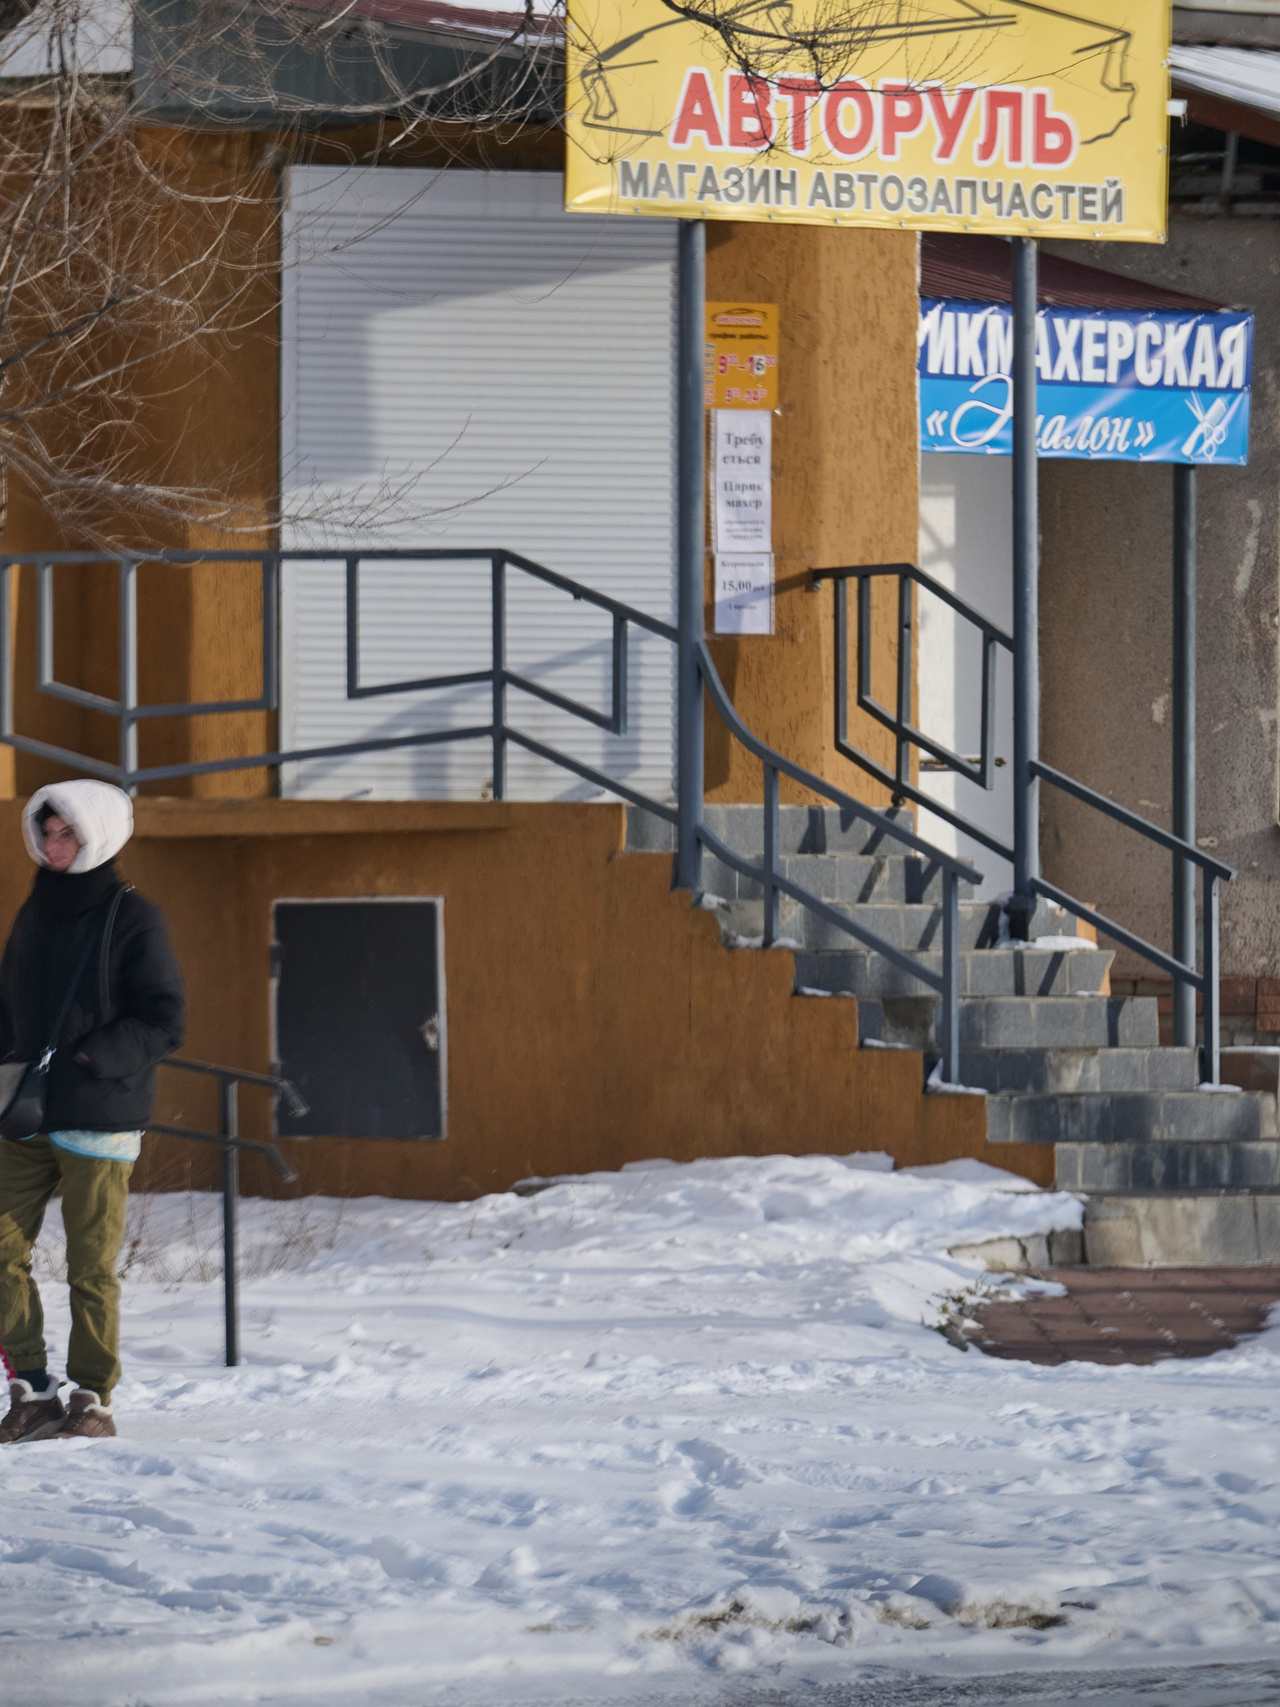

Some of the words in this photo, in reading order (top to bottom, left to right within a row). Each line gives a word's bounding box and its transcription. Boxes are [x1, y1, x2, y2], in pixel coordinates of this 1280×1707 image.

[670, 71, 1074, 165] АВТОРУЛЬ
[619, 161, 797, 206] МАГАЗИН
[808, 171, 1125, 224] АВТОЗАПЧАСТЕЙ
[917, 310, 1248, 388] ИКМАХЕРСКАЯ
[725, 433, 764, 449] Требу
[926, 372, 1156, 454] «Эалон»
